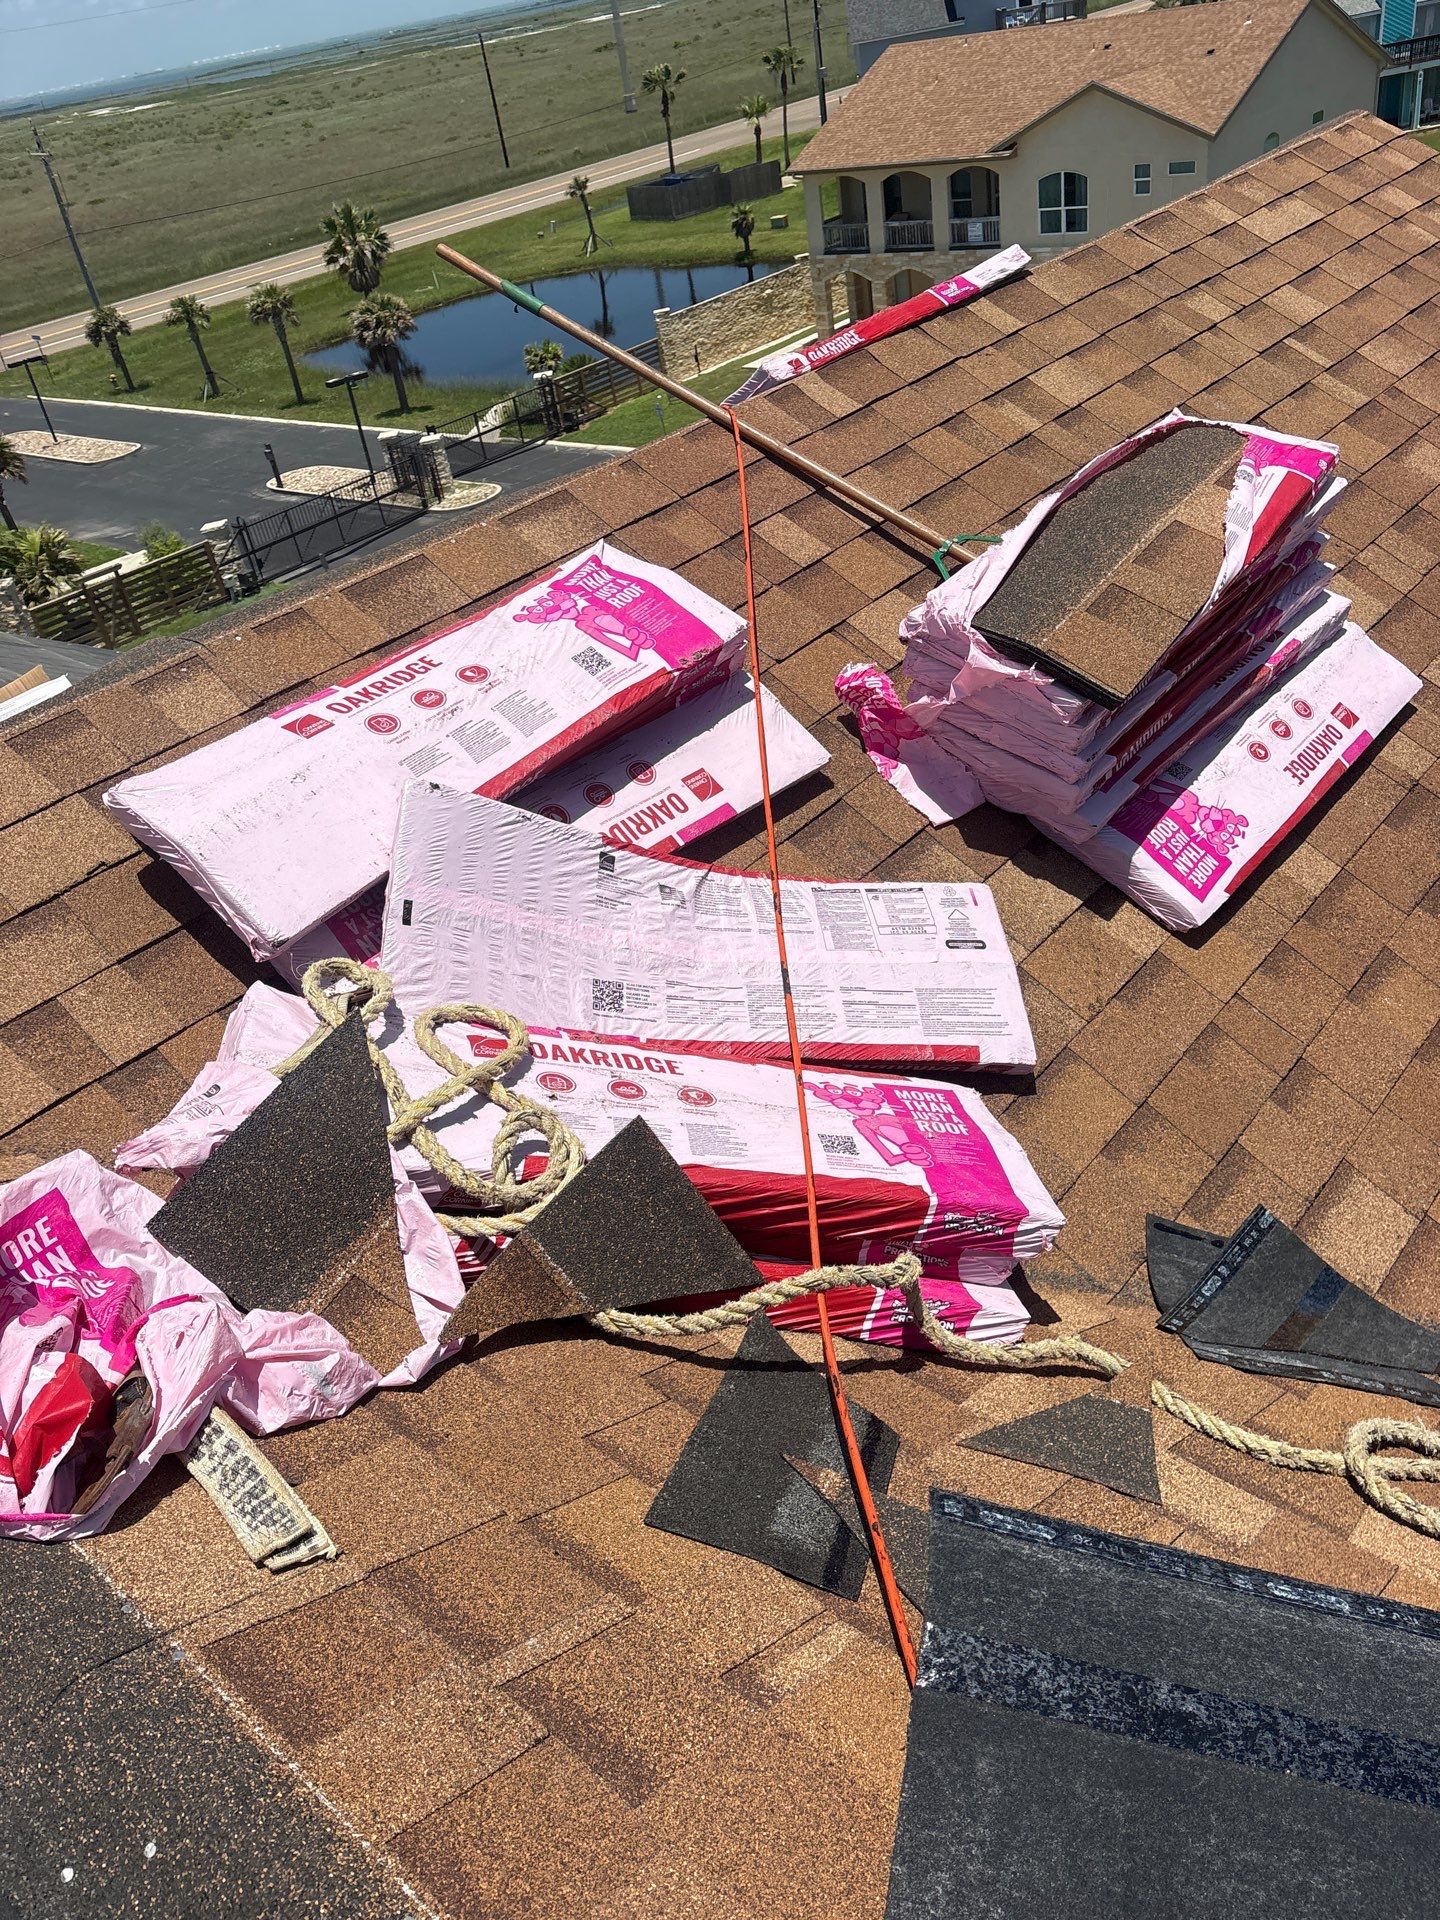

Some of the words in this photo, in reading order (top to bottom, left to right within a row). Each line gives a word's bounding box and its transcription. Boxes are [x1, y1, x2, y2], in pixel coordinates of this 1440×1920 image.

[563, 560, 600, 586] MORE
[576, 569, 616, 592] THAN
[592, 582, 623, 601] JUST
[615, 578, 632, 586] A
[606, 582, 646, 609] ROOF
[326, 655, 443, 714] OAKRIDGE
[1283, 724, 1344, 786] OAKRIDGE
[604, 793, 690, 843] OAKRID
[1146, 816, 1179, 850] ROOF
[1166, 829, 1190, 855] JUST
[1159, 847, 1173, 861] A
[1172, 841, 1206, 877] THAN
[1187, 853, 1219, 890] MORE
[532, 1041, 685, 1076] OAKRIDGE
[894, 1088, 946, 1103] MORE
[900, 1100, 955, 1115] THAN
[911, 1111, 950, 1124] JUST
[952, 1115, 962, 1125] A
[915, 1120, 970, 1136] ROOF
